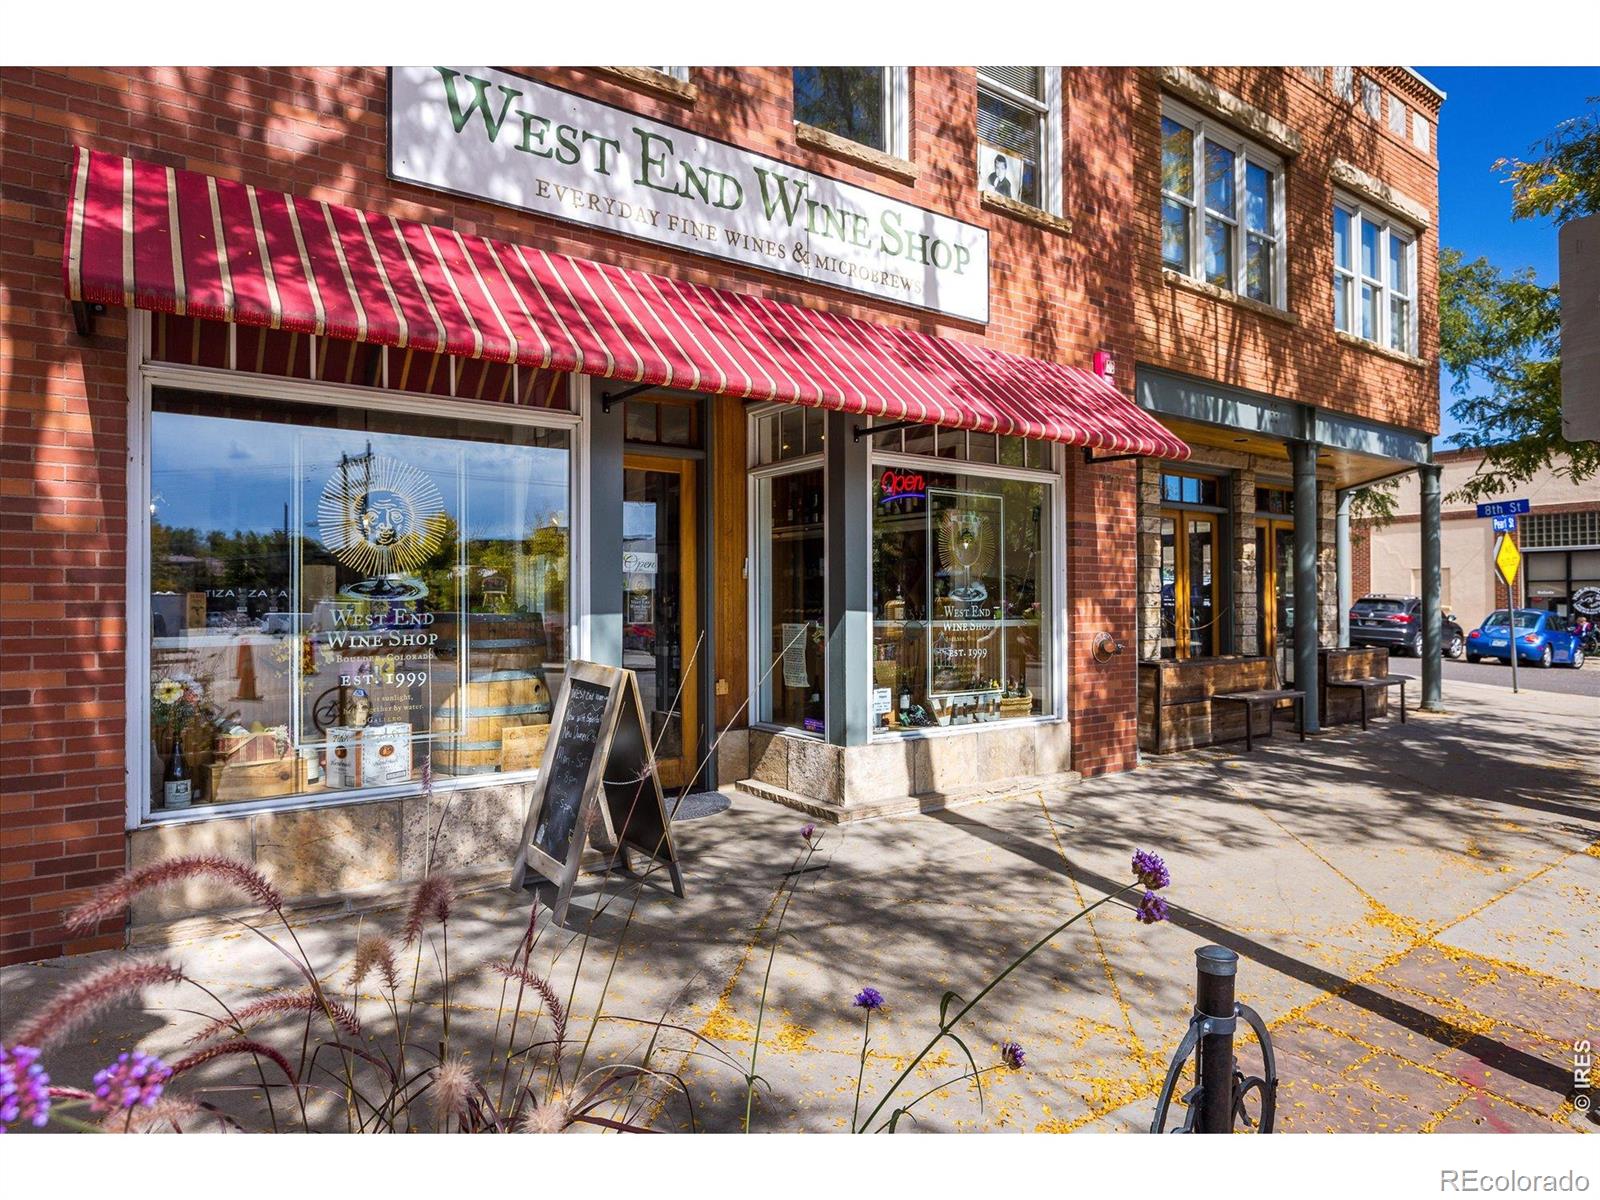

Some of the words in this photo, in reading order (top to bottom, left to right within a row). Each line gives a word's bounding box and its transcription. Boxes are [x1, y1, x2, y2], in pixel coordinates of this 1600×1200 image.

[535, 178, 661, 228] EVERYDAY
[667, 213, 718, 243] FINE
[724, 229, 787, 260] WINES
[792, 240, 810, 265] &
[815, 253, 923, 295] MICROBREWS
[880, 470, 926, 497] Open
[1484, 504, 1504, 516] 8th
[1509, 502, 1522, 513] St
[623, 553, 657, 572] Open
[968, 648, 988, 659] 1999
[386, 671, 428, 689] 1999
